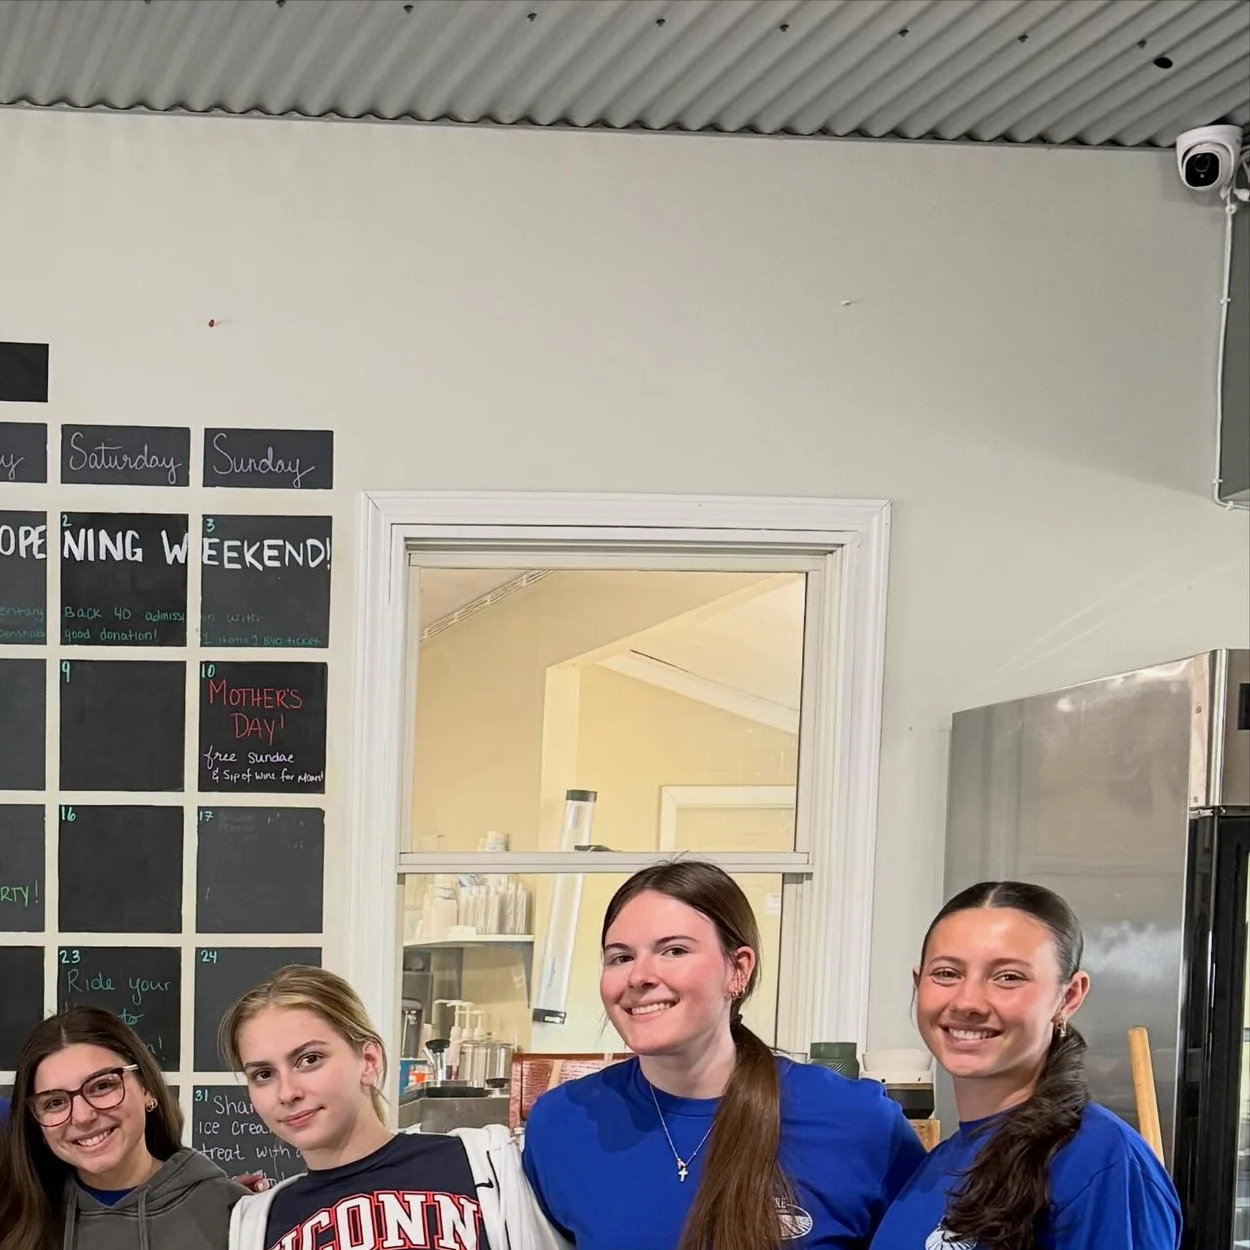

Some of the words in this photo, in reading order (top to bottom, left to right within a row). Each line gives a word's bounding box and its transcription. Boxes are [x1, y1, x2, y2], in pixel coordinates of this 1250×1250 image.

[69, 432, 182, 484] Saturday
[213, 433, 315, 488] Sunday
[62, 514, 72, 528] 2
[206, 518, 215, 532] 3
[61, 661, 71, 683] 9
[201, 663, 216, 678] 10
[203, 745, 238, 770] free
[60, 806, 77, 822] 16
[199, 810, 214, 822] 17
[59, 949, 81, 964] 23
[200, 950, 218, 964] 24
[67, 968, 116, 993] Ride
[128, 976, 172, 1006] your
[194, 1089, 209, 1102] 31
[231, 1120, 273, 1136] crea
[199, 1143, 245, 1161] treat
